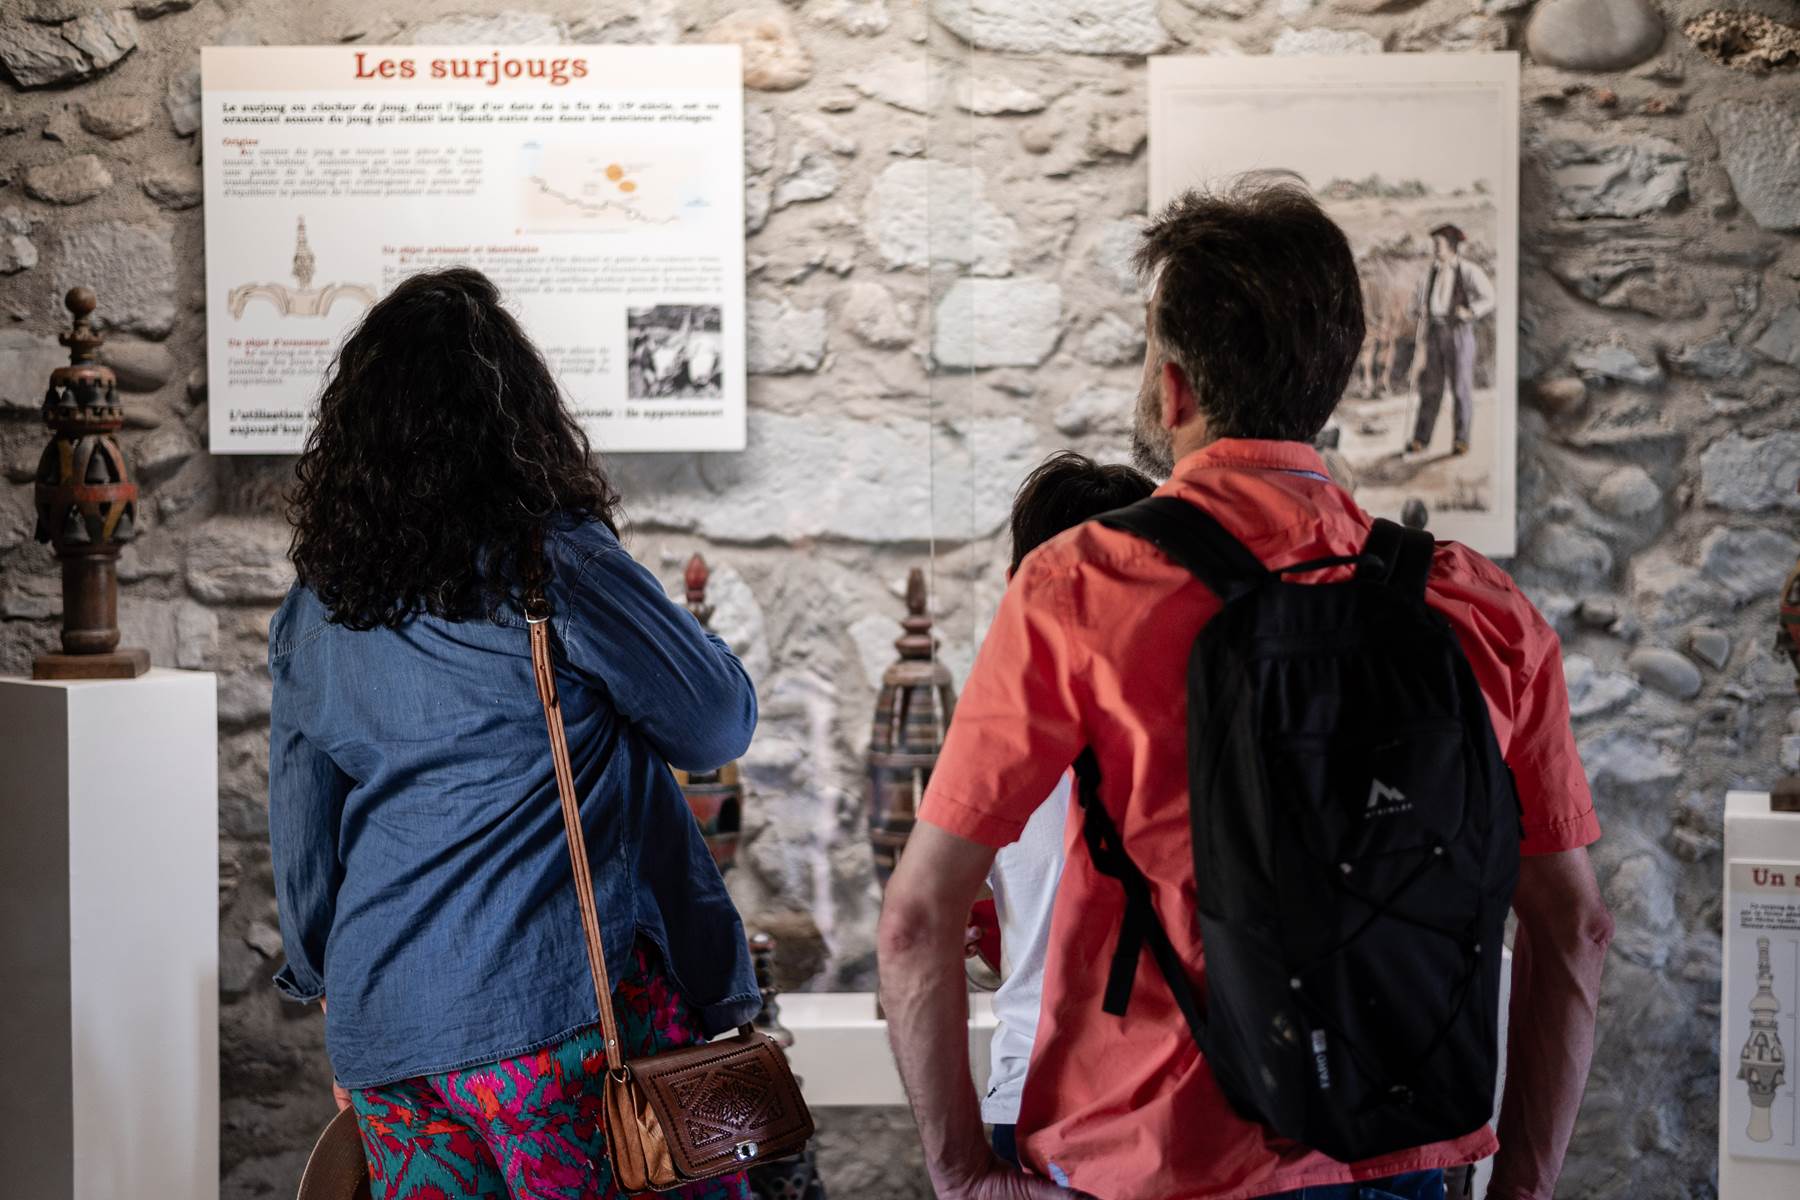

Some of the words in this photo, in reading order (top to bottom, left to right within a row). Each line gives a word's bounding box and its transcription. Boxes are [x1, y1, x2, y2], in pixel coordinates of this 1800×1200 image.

[354, 52, 417, 79] Les
[430, 51, 590, 86] surjougs
[1752, 868, 1786, 887] Un
